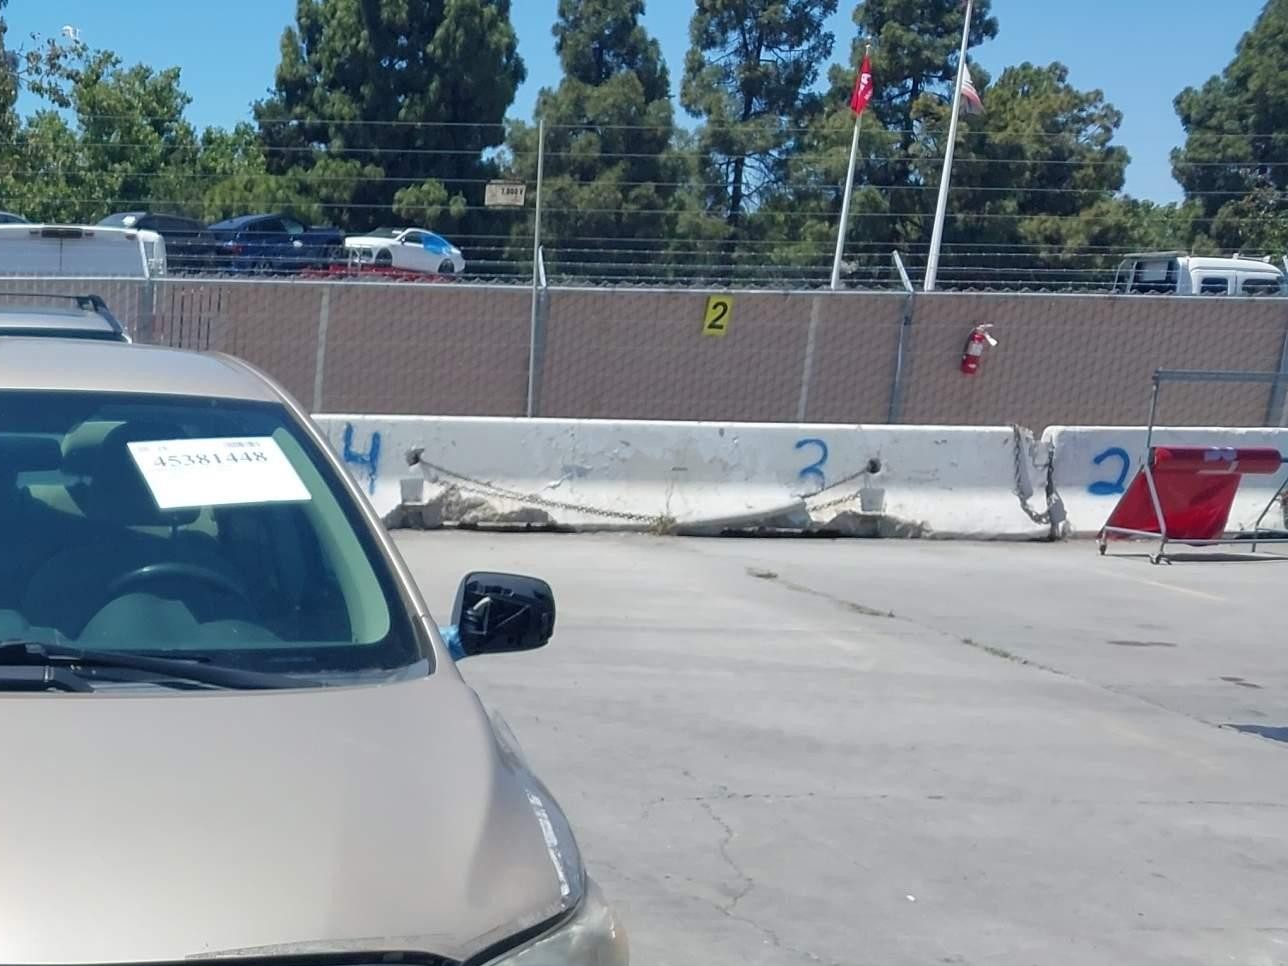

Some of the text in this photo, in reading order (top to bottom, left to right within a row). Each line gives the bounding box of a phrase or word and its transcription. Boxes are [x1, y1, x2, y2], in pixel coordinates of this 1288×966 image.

[707, 301, 728, 330] 2
[153, 451, 268, 467] 45381448
[344, 422, 380, 495] 4
[1087, 447, 1130, 495] 2
